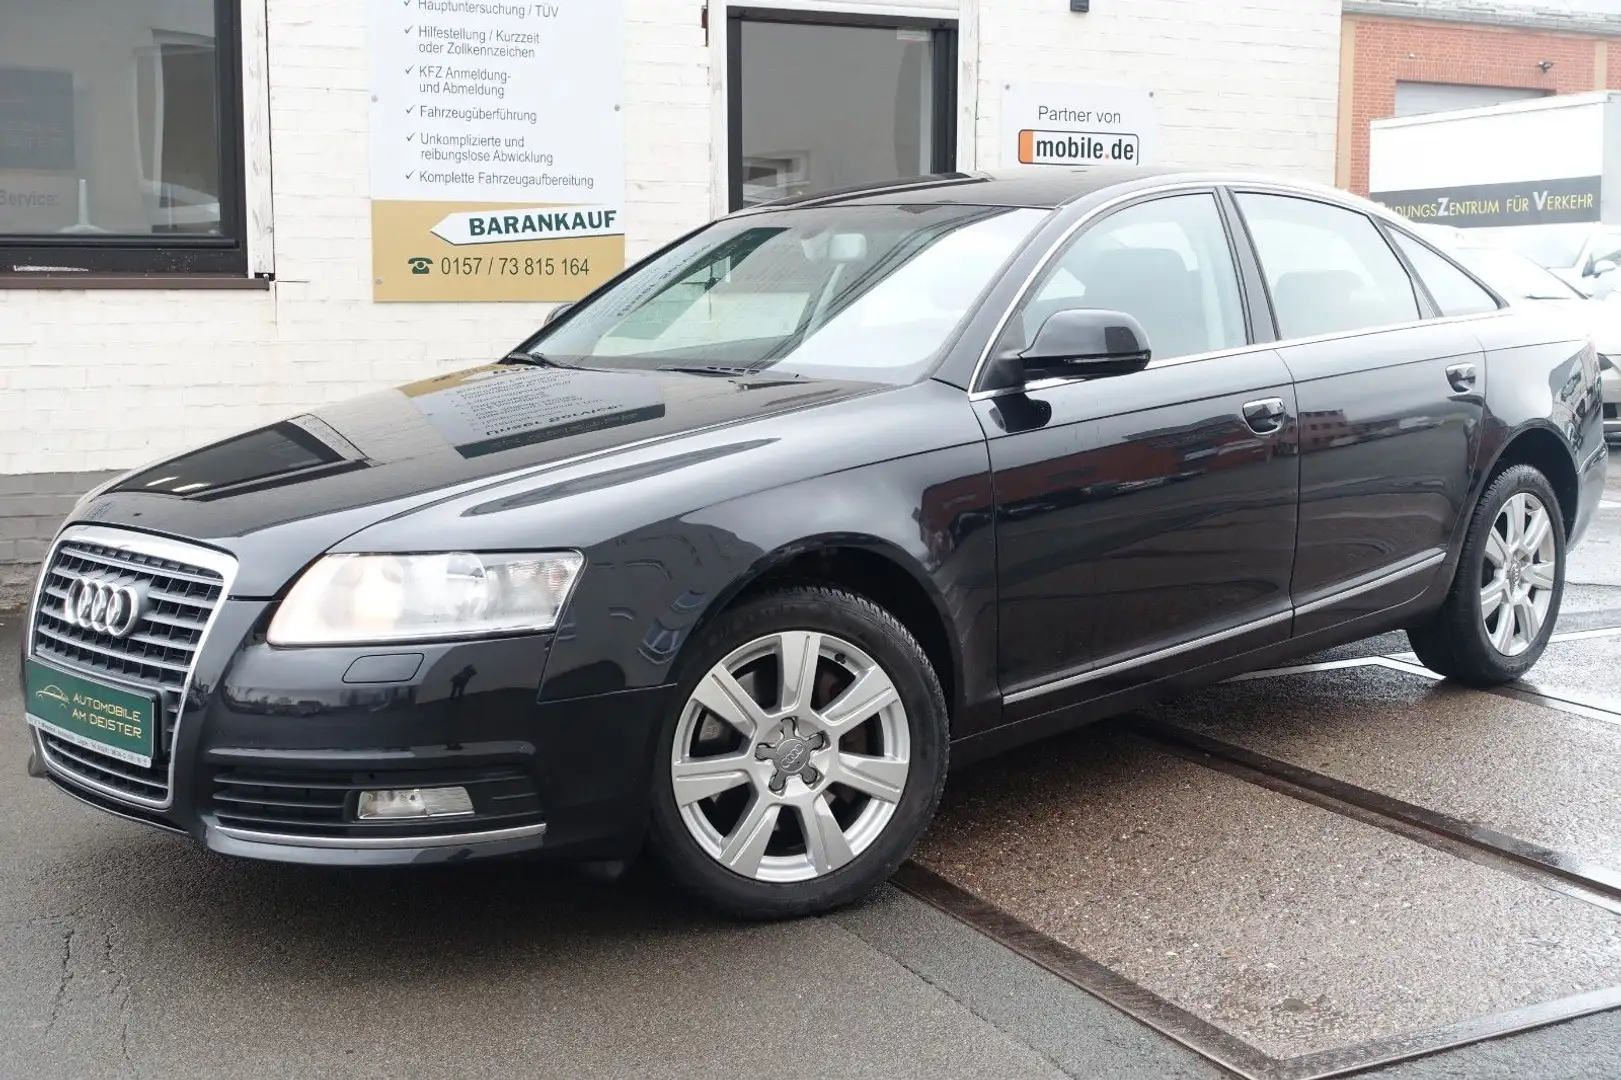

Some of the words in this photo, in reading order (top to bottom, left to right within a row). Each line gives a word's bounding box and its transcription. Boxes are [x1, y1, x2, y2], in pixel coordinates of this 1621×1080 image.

[418, 0, 525, 19] Hauptuntersuchung
[535, 3, 560, 17] TÜV
[418, 25, 486, 43] Hilfestellung
[496, 30, 540, 43] Kurzzeit
[418, 42, 444, 54] oder
[447, 42, 535, 58] Zollkennzeichen
[419, 66, 443, 78] KFZ
[446, 67, 511, 83] Anmeldung-
[419, 82, 440, 94] und
[443, 83, 505, 99] Abmeldung
[420, 105, 538, 124] Fahrzeugüberführung
[1038, 105, 1092, 122] Partner
[1096, 111, 1121, 124] von
[420, 134, 501, 150] Unkomplizierte
[504, 136, 525, 148] und
[1036, 136, 1134, 160] mobile.de
[421, 149, 490, 164] reibungslose
[493, 150, 554, 166] Abwicklung
[419, 171, 475, 186] Komplette
[478, 172, 594, 189] Fahrzeugaufbereitung
[1506, 194, 1529, 212] FÜR
[1532, 190, 1594, 211] VERKEHR
[469, 209, 617, 236] BARANKAUF
[441, 257, 482, 275] 0157
[488, 257, 494, 275] /
[499, 257, 519, 276] 73
[524, 257, 555, 276] 815
[561, 258, 590, 276] 164
[72, 692, 141, 722] AUTOMOBILE
[71, 708, 88, 722] AM
[89, 715, 143, 739] DEISTER
